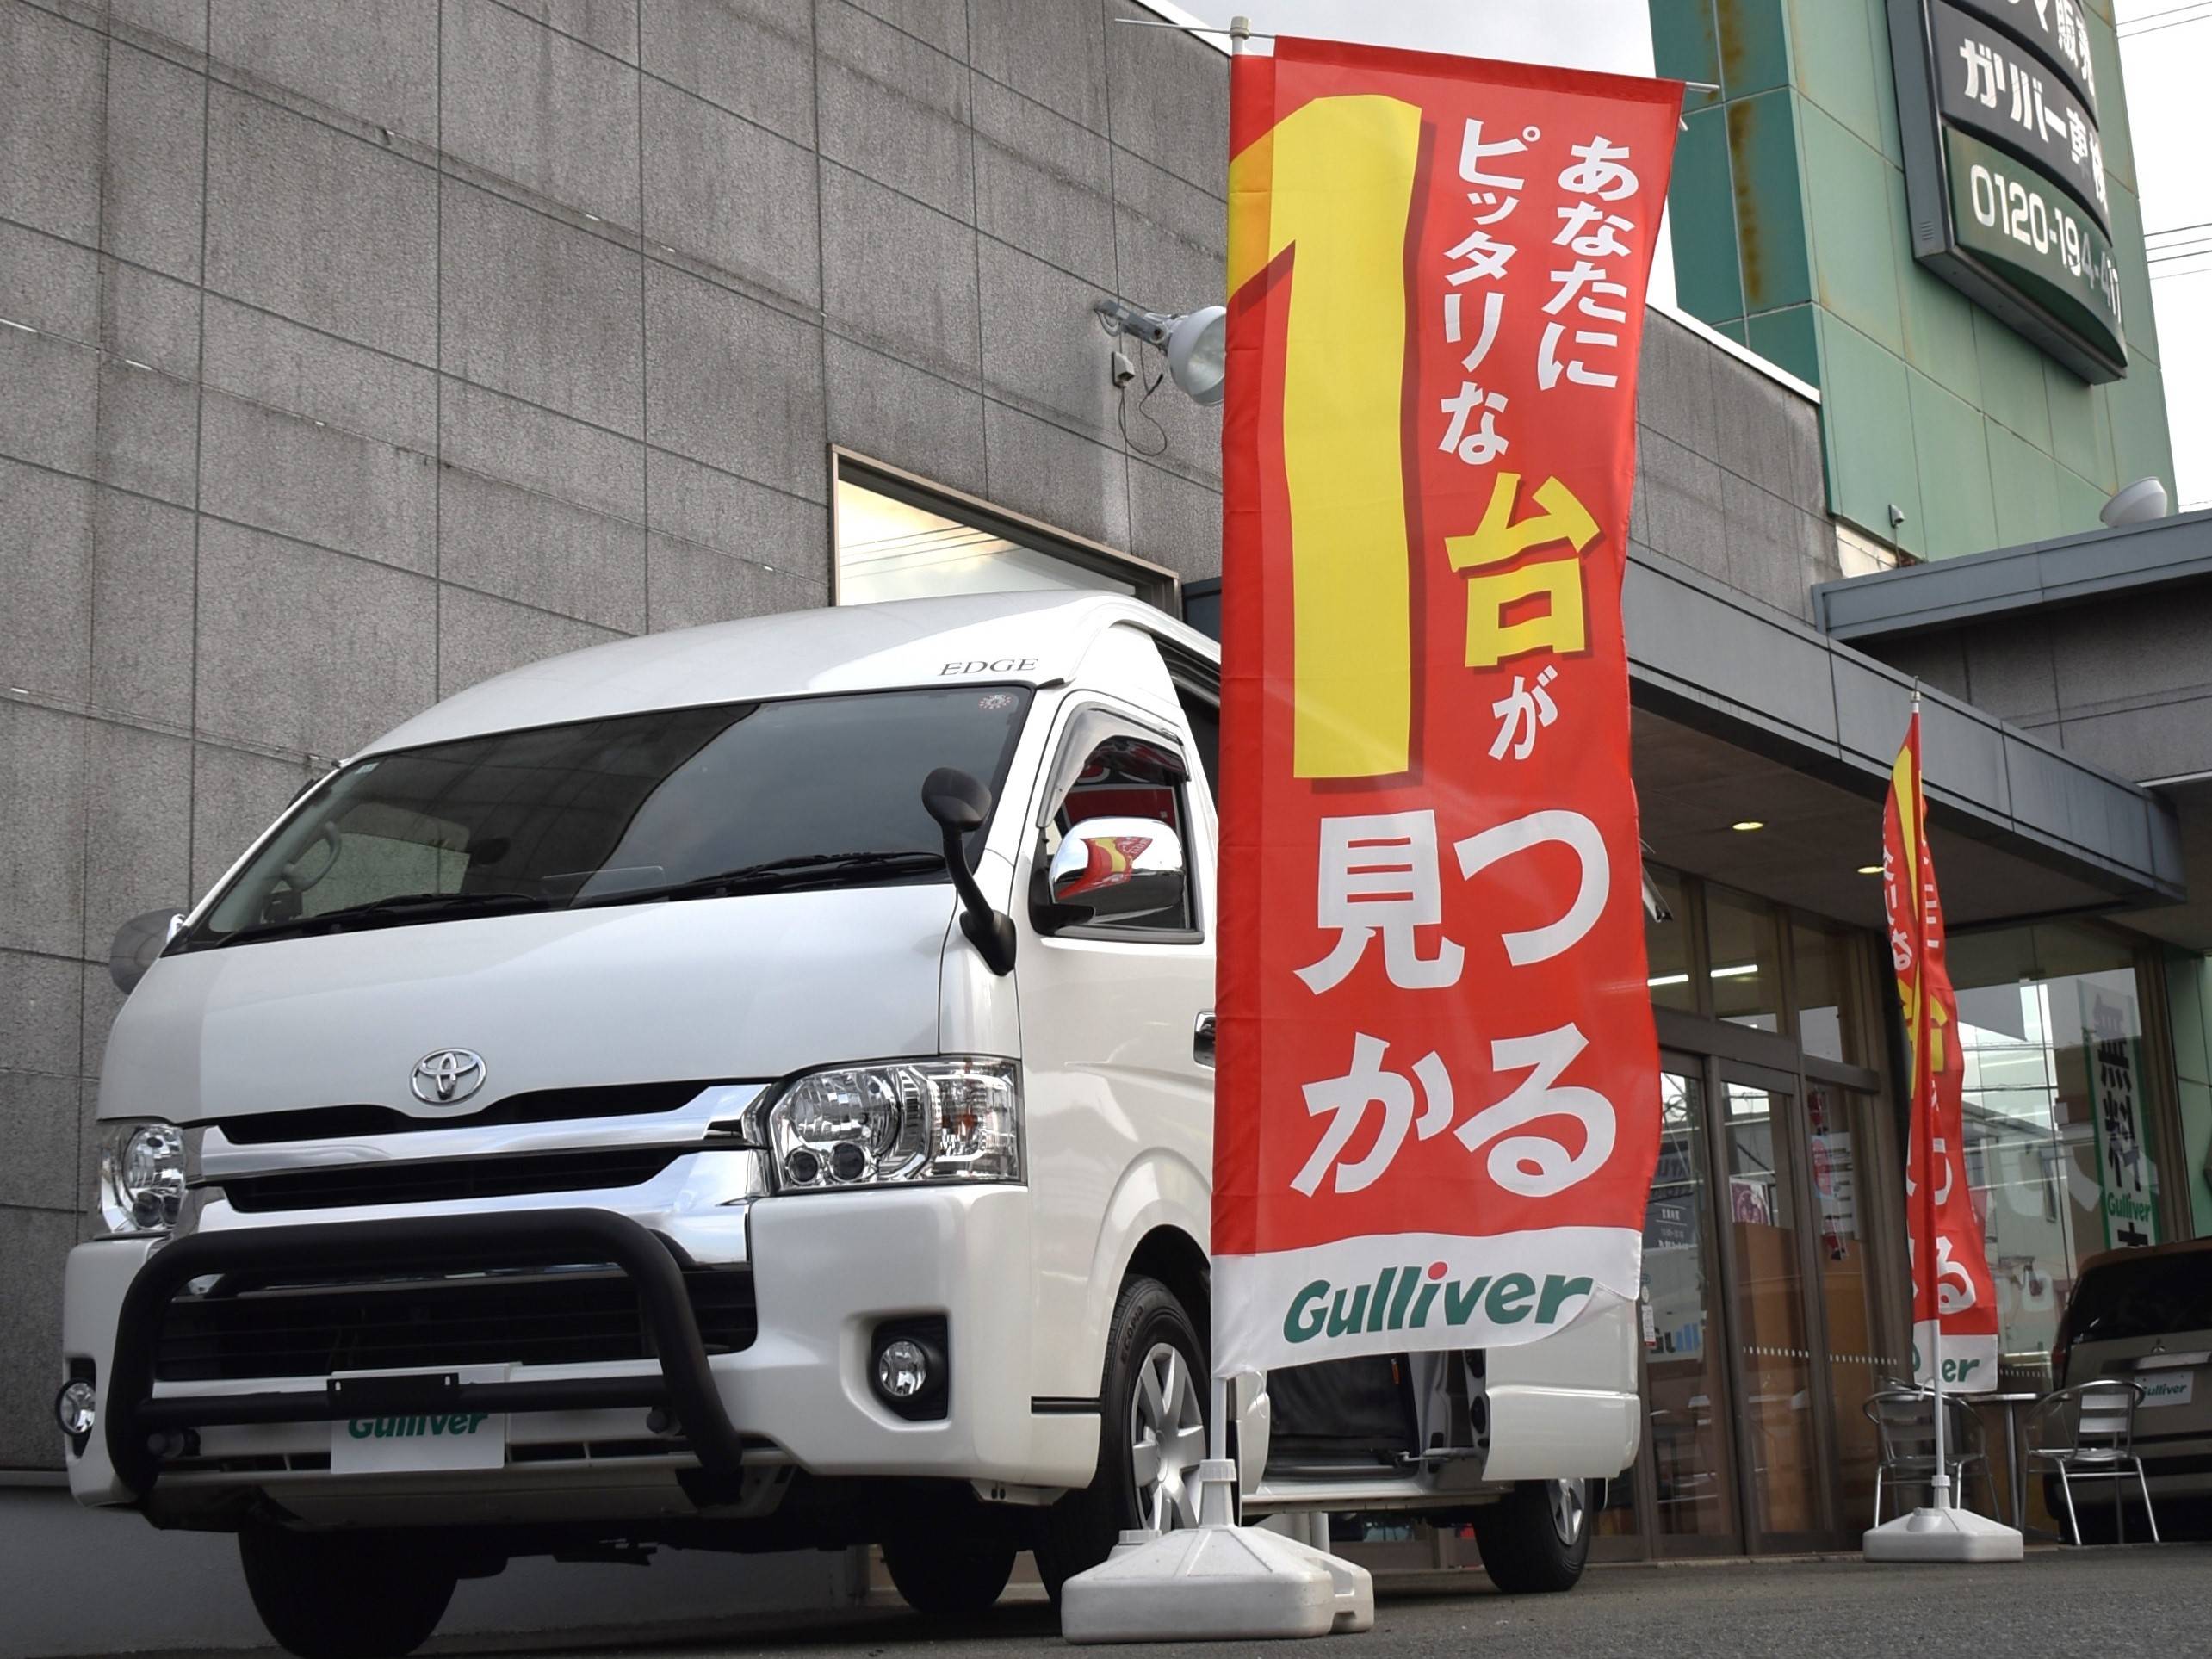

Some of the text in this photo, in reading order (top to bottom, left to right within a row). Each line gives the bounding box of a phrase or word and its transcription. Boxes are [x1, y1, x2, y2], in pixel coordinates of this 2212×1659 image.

[1537, 134, 1639, 391] あなたに
[937, 658, 1039, 677] EDGE
[2108, 1192, 2151, 1222] Gulliver
[1282, 1260, 1594, 1344] Gulliver
[2144, 1383, 2187, 1396] ulliver
